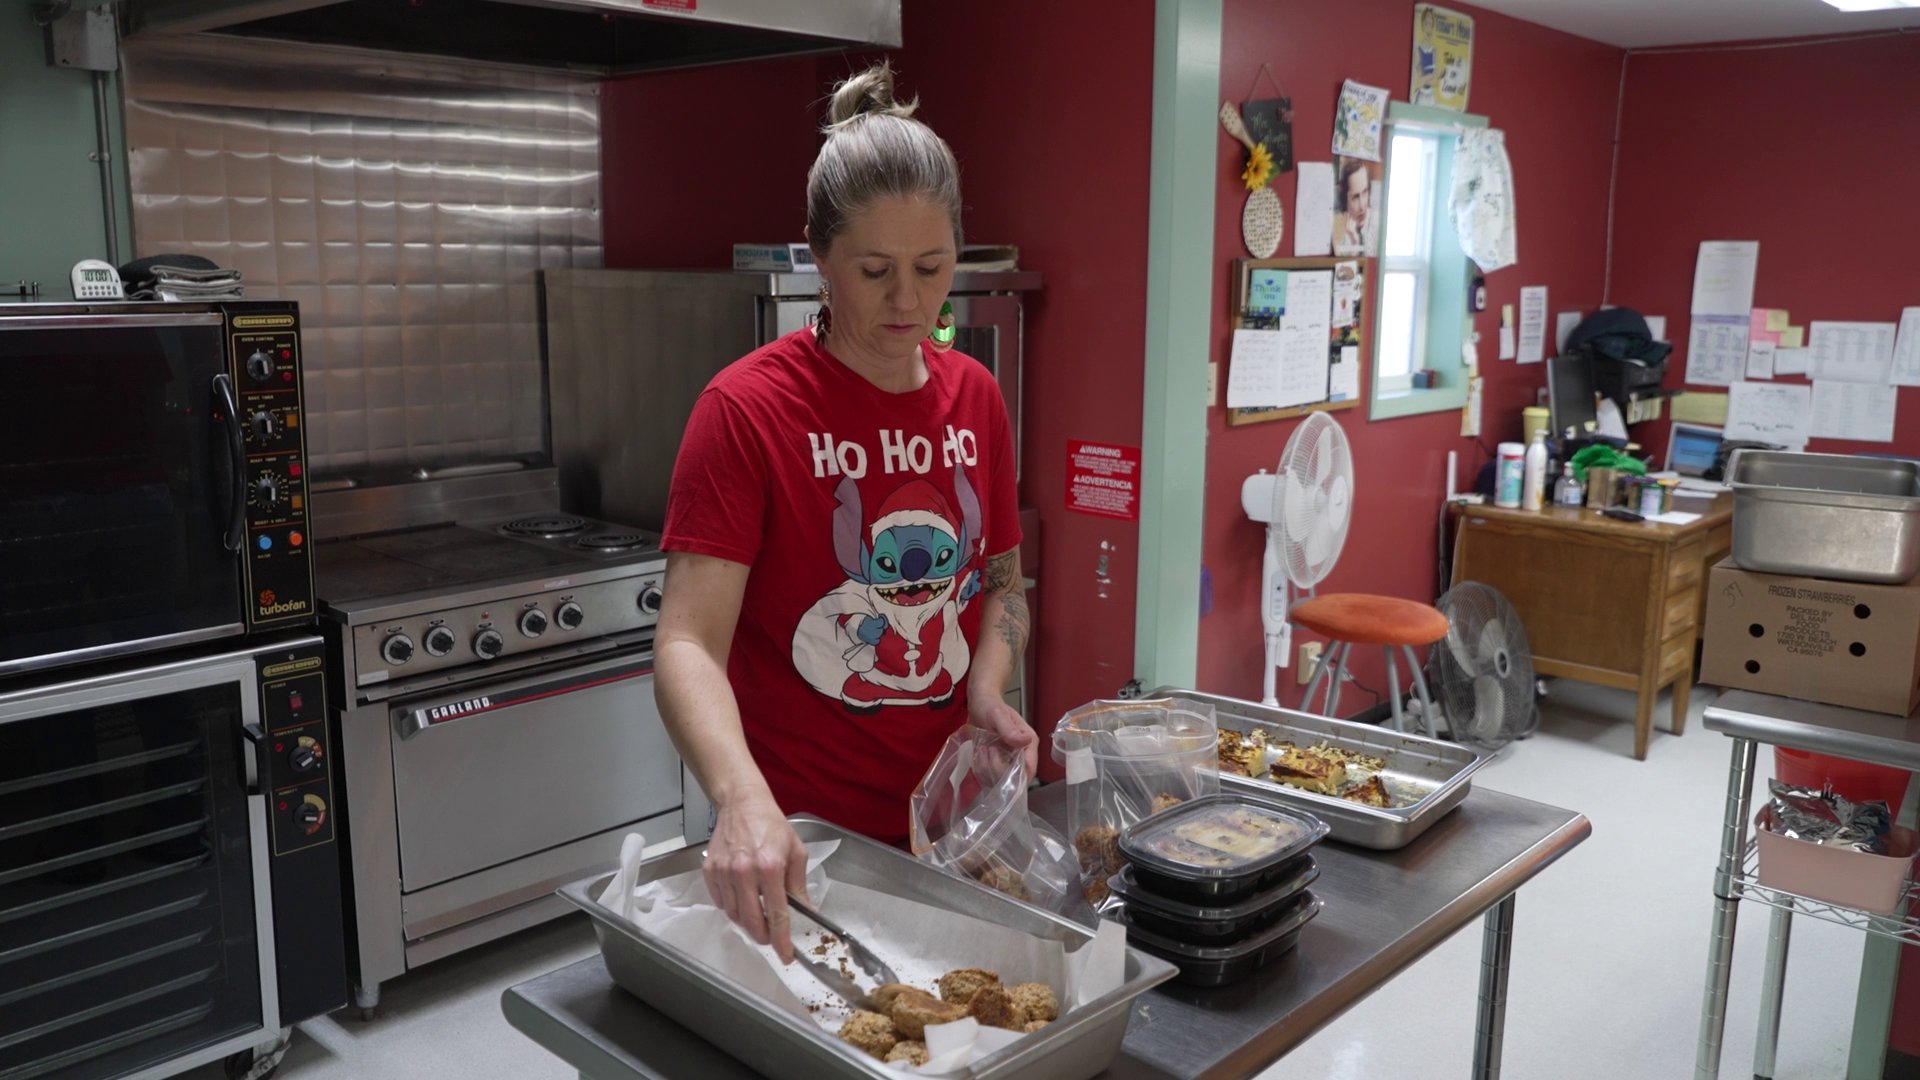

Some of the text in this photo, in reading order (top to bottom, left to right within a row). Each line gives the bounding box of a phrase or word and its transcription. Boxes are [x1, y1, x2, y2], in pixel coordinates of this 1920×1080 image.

[1253, 283, 1281, 293] Thank
[807, 424, 977, 479] HO HO HO
[1086, 446, 1121, 458] WARNING
[1080, 475, 1133, 491] ADVERTENCIA
[1722, 581, 1744, 608] 37
[1768, 584, 1856, 606] FROZEN STRAWBERRIES
[260, 600, 306, 616] turbofan
[1786, 605, 1819, 616] PACKED
[1790, 613, 1827, 624] DEL MAR
[1796, 620, 1820, 629] FOOD
[1777, 631, 1795, 640] 1720
[1808, 636, 1837, 646] BEACH
[1784, 625, 1830, 638] PRODUCTS
[1777, 638, 1835, 652] WATSONVILLE
[1786, 646, 1799, 654] CA
[431, 697, 490, 720] GARLAND
